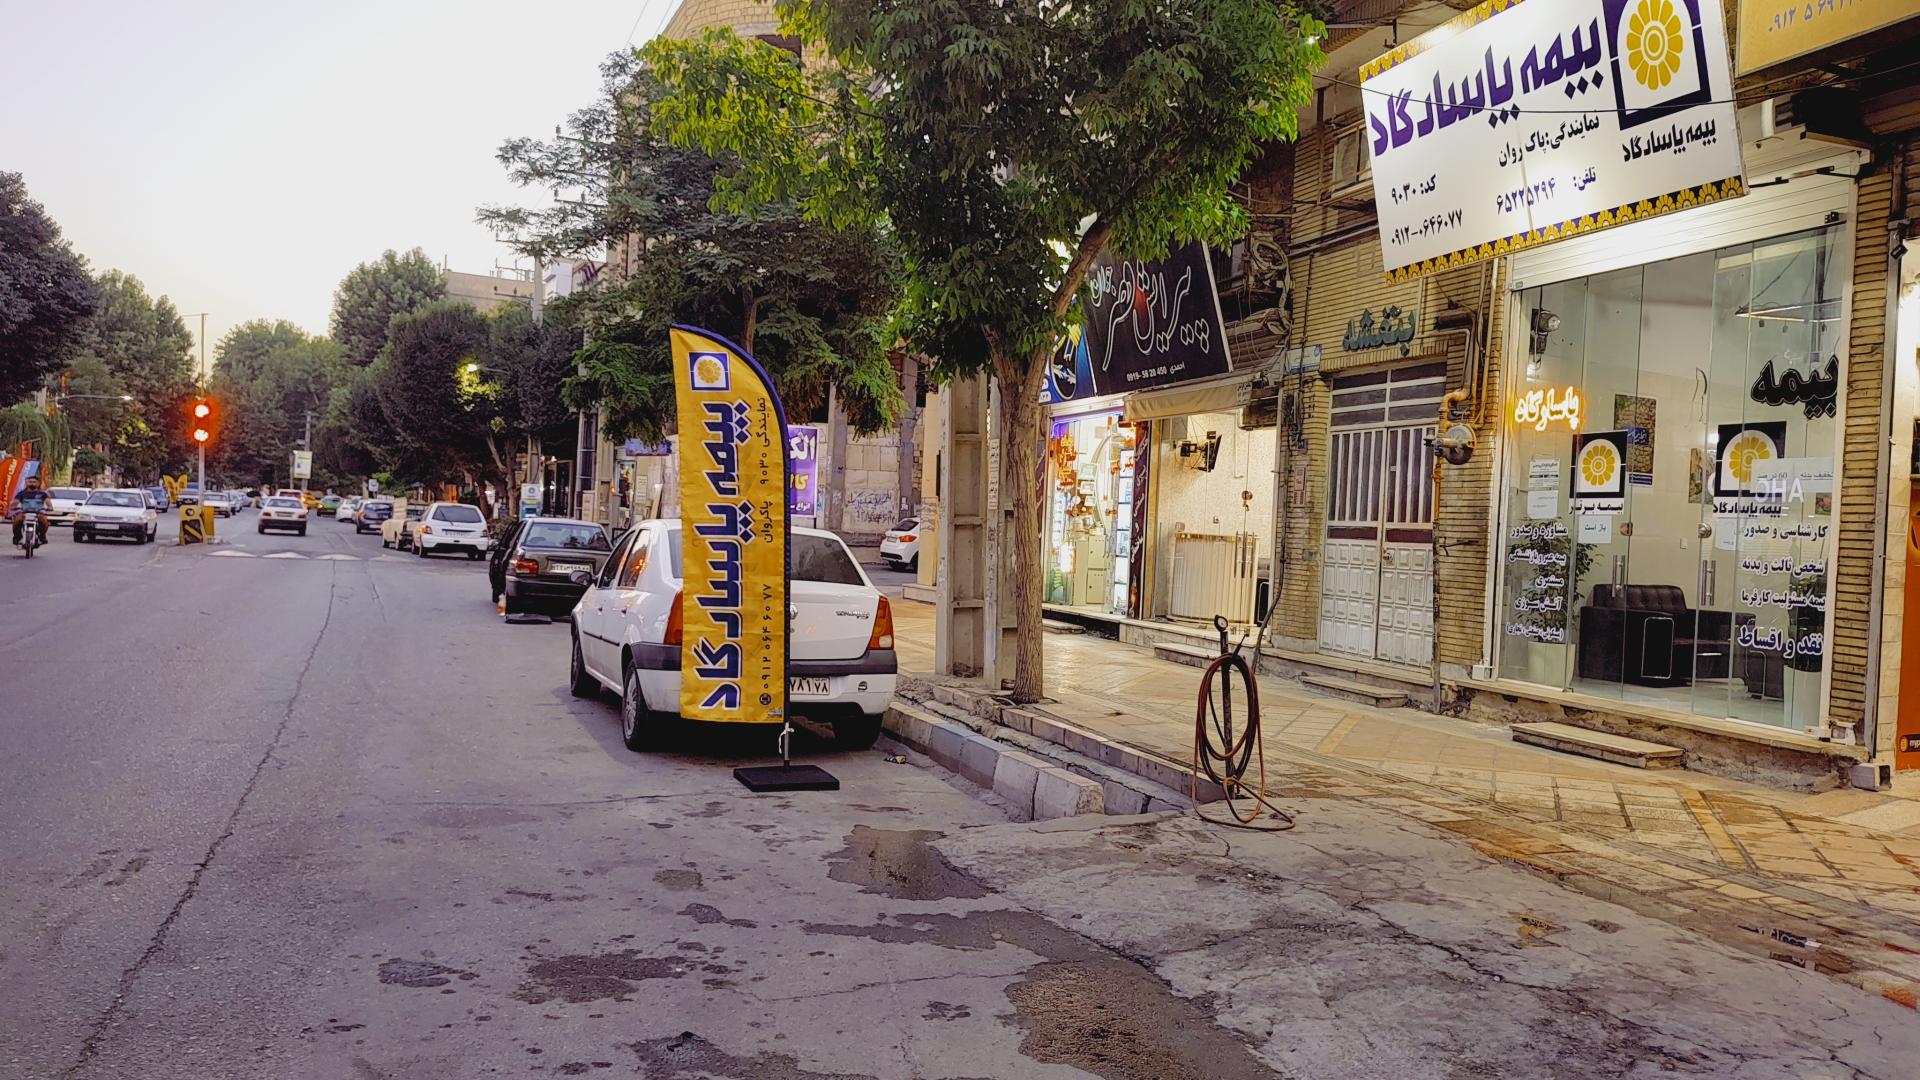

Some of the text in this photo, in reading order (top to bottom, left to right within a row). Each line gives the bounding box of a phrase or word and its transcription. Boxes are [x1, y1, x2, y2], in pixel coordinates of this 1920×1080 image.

[1370, 16, 1604, 157] بیمه پاسارگاد
[1622, 118, 1717, 162] بیمه پاسارگاد
[1499, 141, 1524, 168] روان
[1391, 183, 1417, 206] ۹۰۳۰
[1751, 353, 1840, 420] بیمه
[756, 397, 771, 448] نمایندگی
[1597, 502, 1624, 515] بیمه
[1712, 501, 1782, 518] بیمه پاسارگاد
[1511, 524, 1532, 537] صدور
[1540, 522, 1568, 537] مشاوره
[1744, 525, 1771, 538] صدور
[1780, 524, 1829, 541] کارشناسی
[692, 399, 756, 711] بیمه پاسارگاد
[1742, 558, 1761, 574] بدنه
[1771, 557, 1792, 572] ثالث
[1794, 560, 1824, 577] شخص
[1808, 595, 1826, 611] بیمه
[1738, 626, 1824, 657] نقد و اقساط
